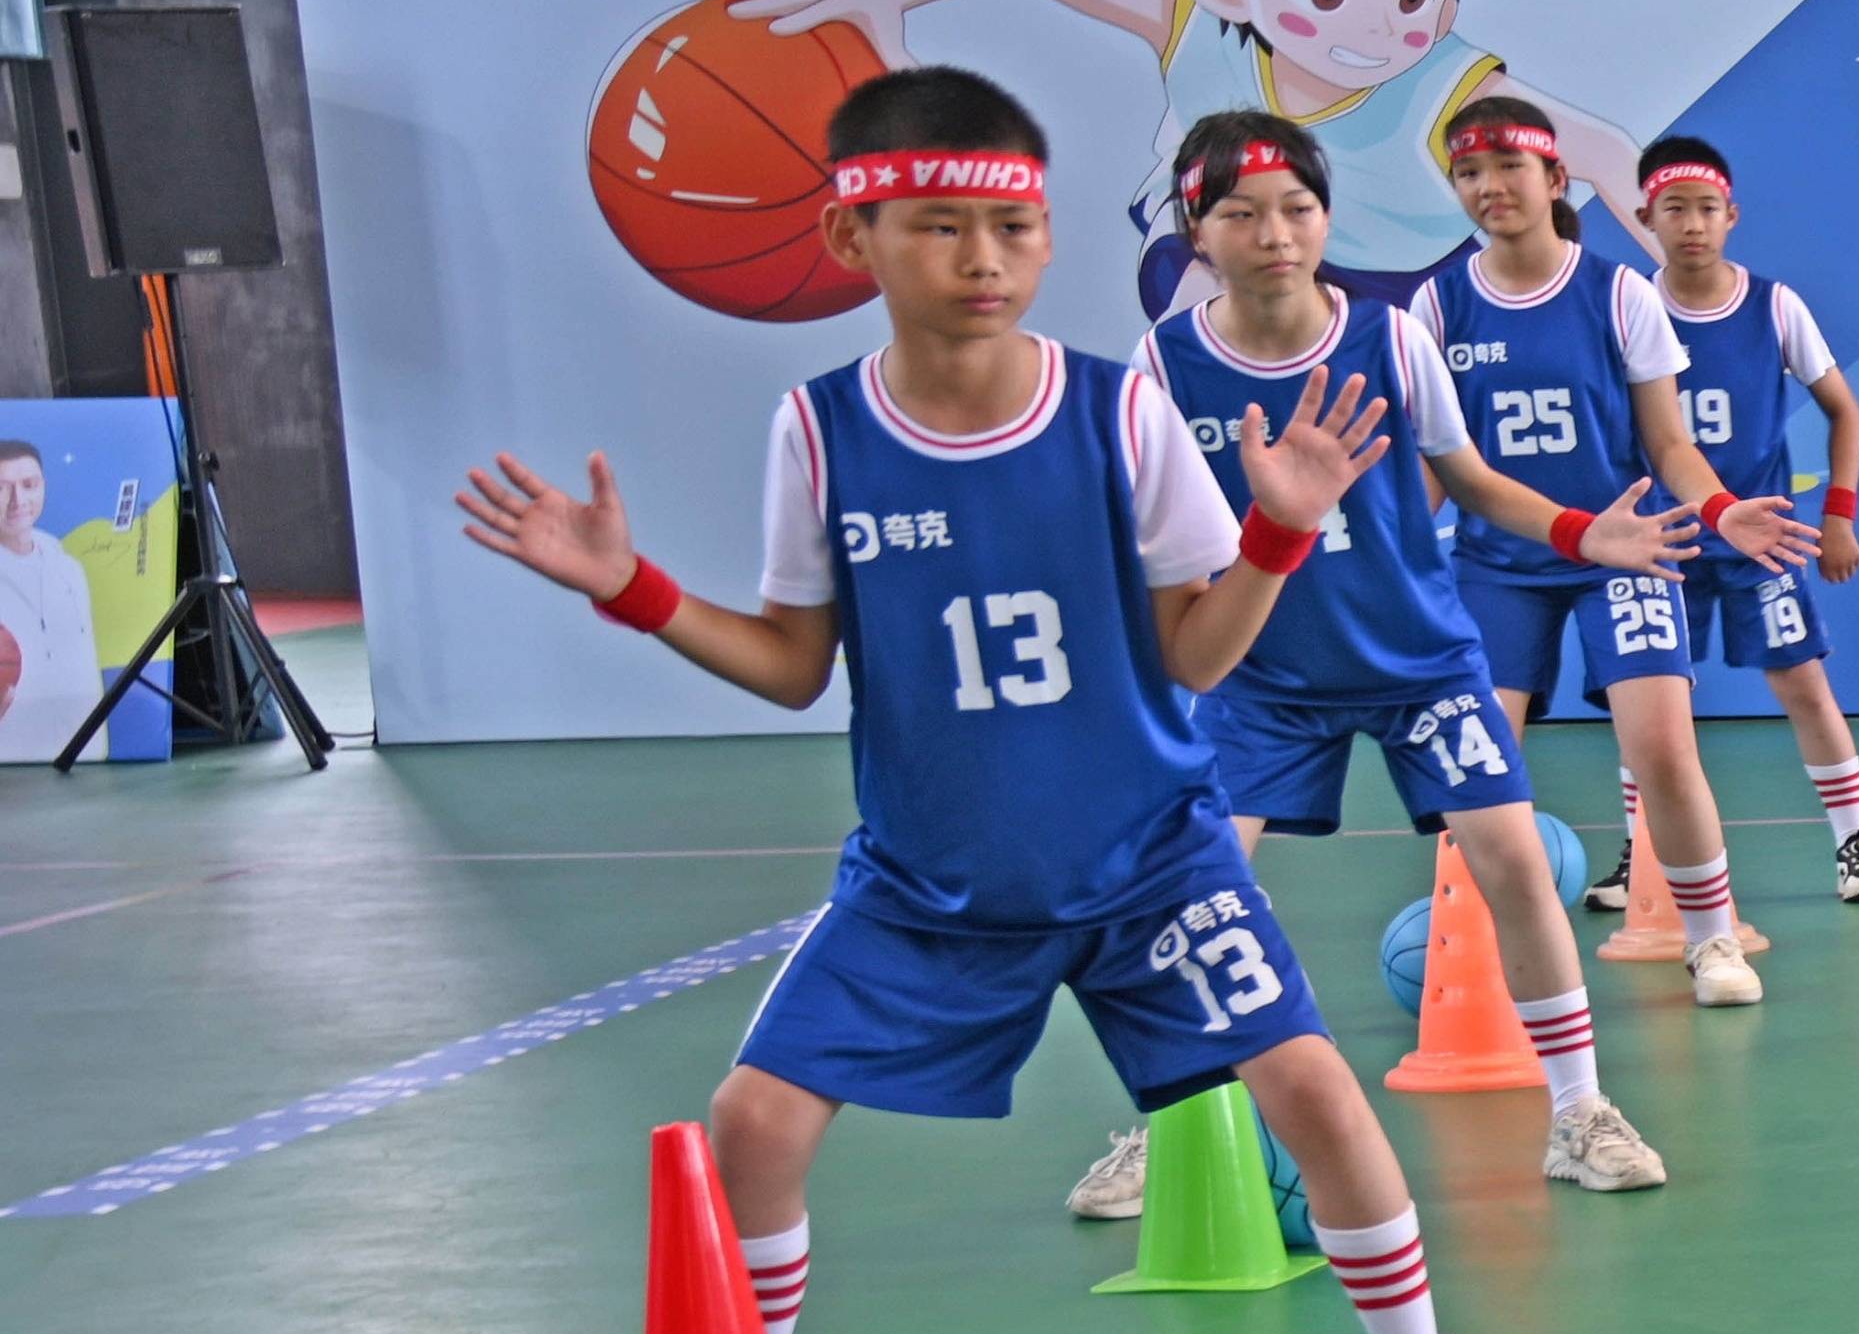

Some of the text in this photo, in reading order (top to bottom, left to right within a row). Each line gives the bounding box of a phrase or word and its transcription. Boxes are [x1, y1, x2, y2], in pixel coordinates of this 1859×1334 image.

[912, 160, 1027, 191] CHINA
[1659, 165, 1718, 184] CHINA
[1473, 340, 1508, 365] 夸克
[1494, 388, 1578, 456] 25
[1678, 388, 1732, 444] 19
[882, 511, 953, 552] 夸克
[1610, 599, 1678, 653] 25
[1763, 597, 1808, 649] 19
[942, 591, 1072, 711] 13
[1430, 714, 1508, 787] 14
[1183, 889, 1250, 933] 夸克
[1175, 927, 1284, 1032] 13
